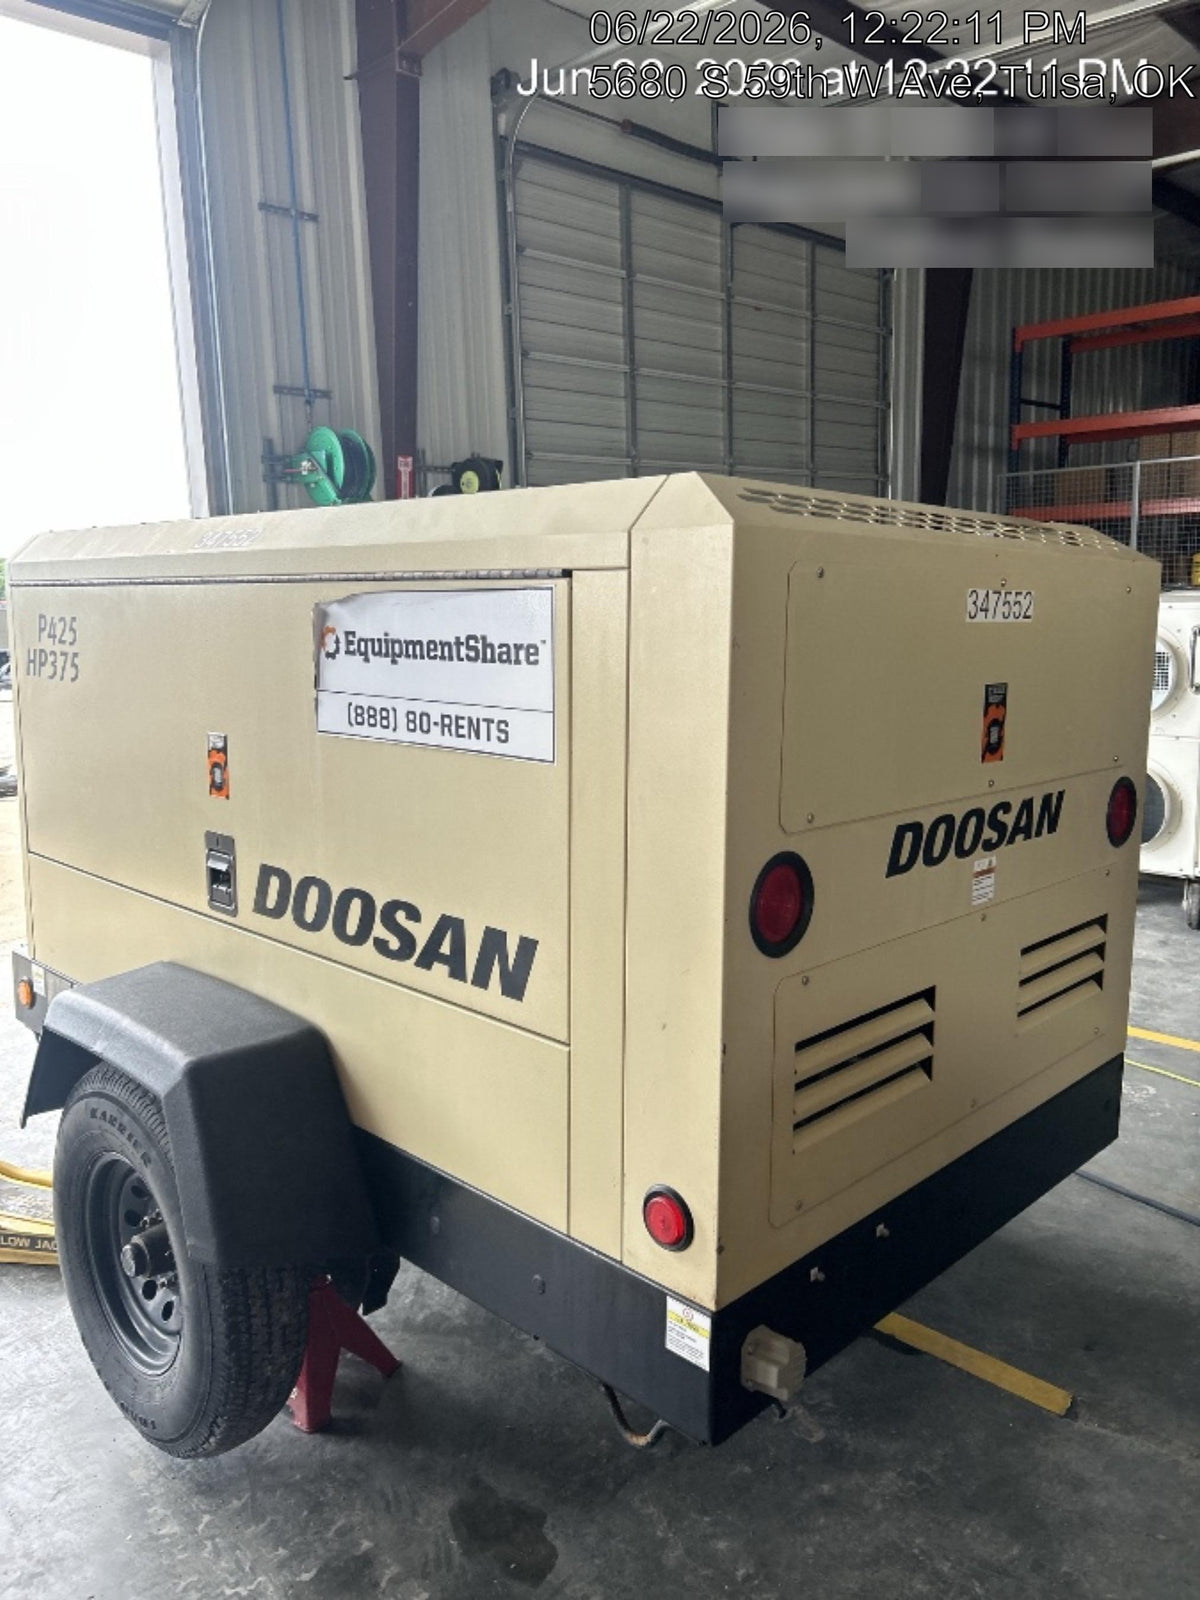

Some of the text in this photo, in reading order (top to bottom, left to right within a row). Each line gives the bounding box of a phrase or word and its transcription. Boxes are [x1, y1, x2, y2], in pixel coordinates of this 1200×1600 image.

[967, 589, 1033, 620] 347552
[38, 613, 77, 646] P425
[26, 647, 80, 683] HP375
[343, 630, 540, 666] EquipmentShare
[347, 702, 510, 744] (888) 80-RENTS
[885, 789, 1066, 878] DOOSAN
[252, 862, 540, 1003] DOOSAN
